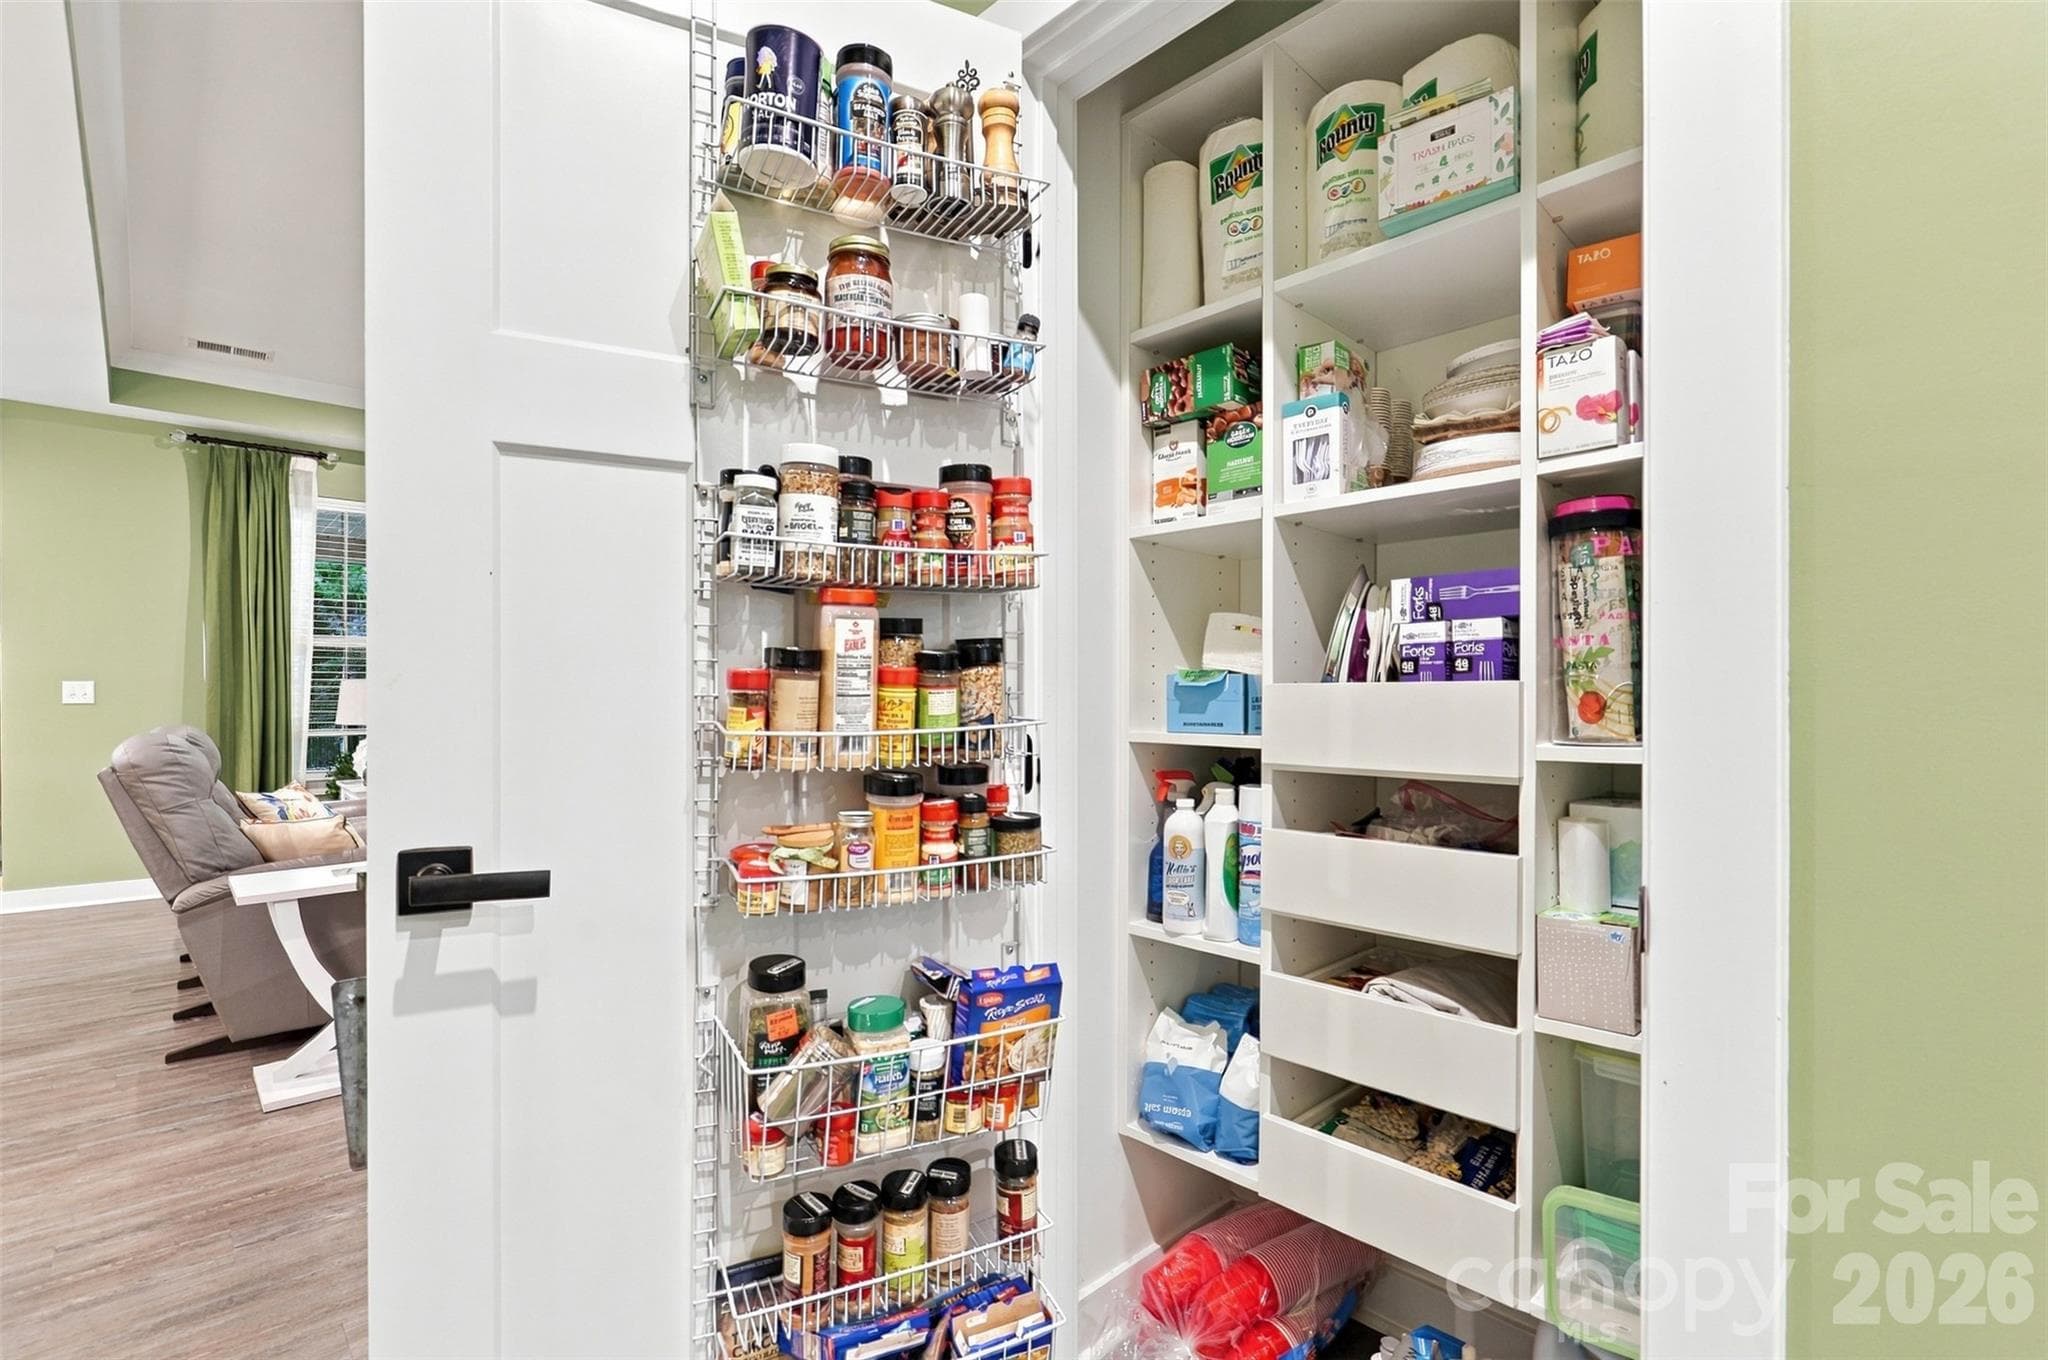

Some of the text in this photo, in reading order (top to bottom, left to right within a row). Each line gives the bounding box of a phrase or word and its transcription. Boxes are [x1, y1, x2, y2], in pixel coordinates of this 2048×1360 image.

[1320, 111, 1377, 161] Bounty
[1412, 144, 1446, 161] TRASH
[1576, 246, 1610, 264] TAZO
[1546, 347, 1592, 369] TAZO
[1412, 586, 1425, 620] Forks
[1402, 644, 1436, 657] Forks
[1453, 641, 1486, 654] Forks
[1401, 660, 1415, 673] 48
[874, 1071, 903, 1084] Ranch
[1144, 1102, 1192, 1119] epsom salt
